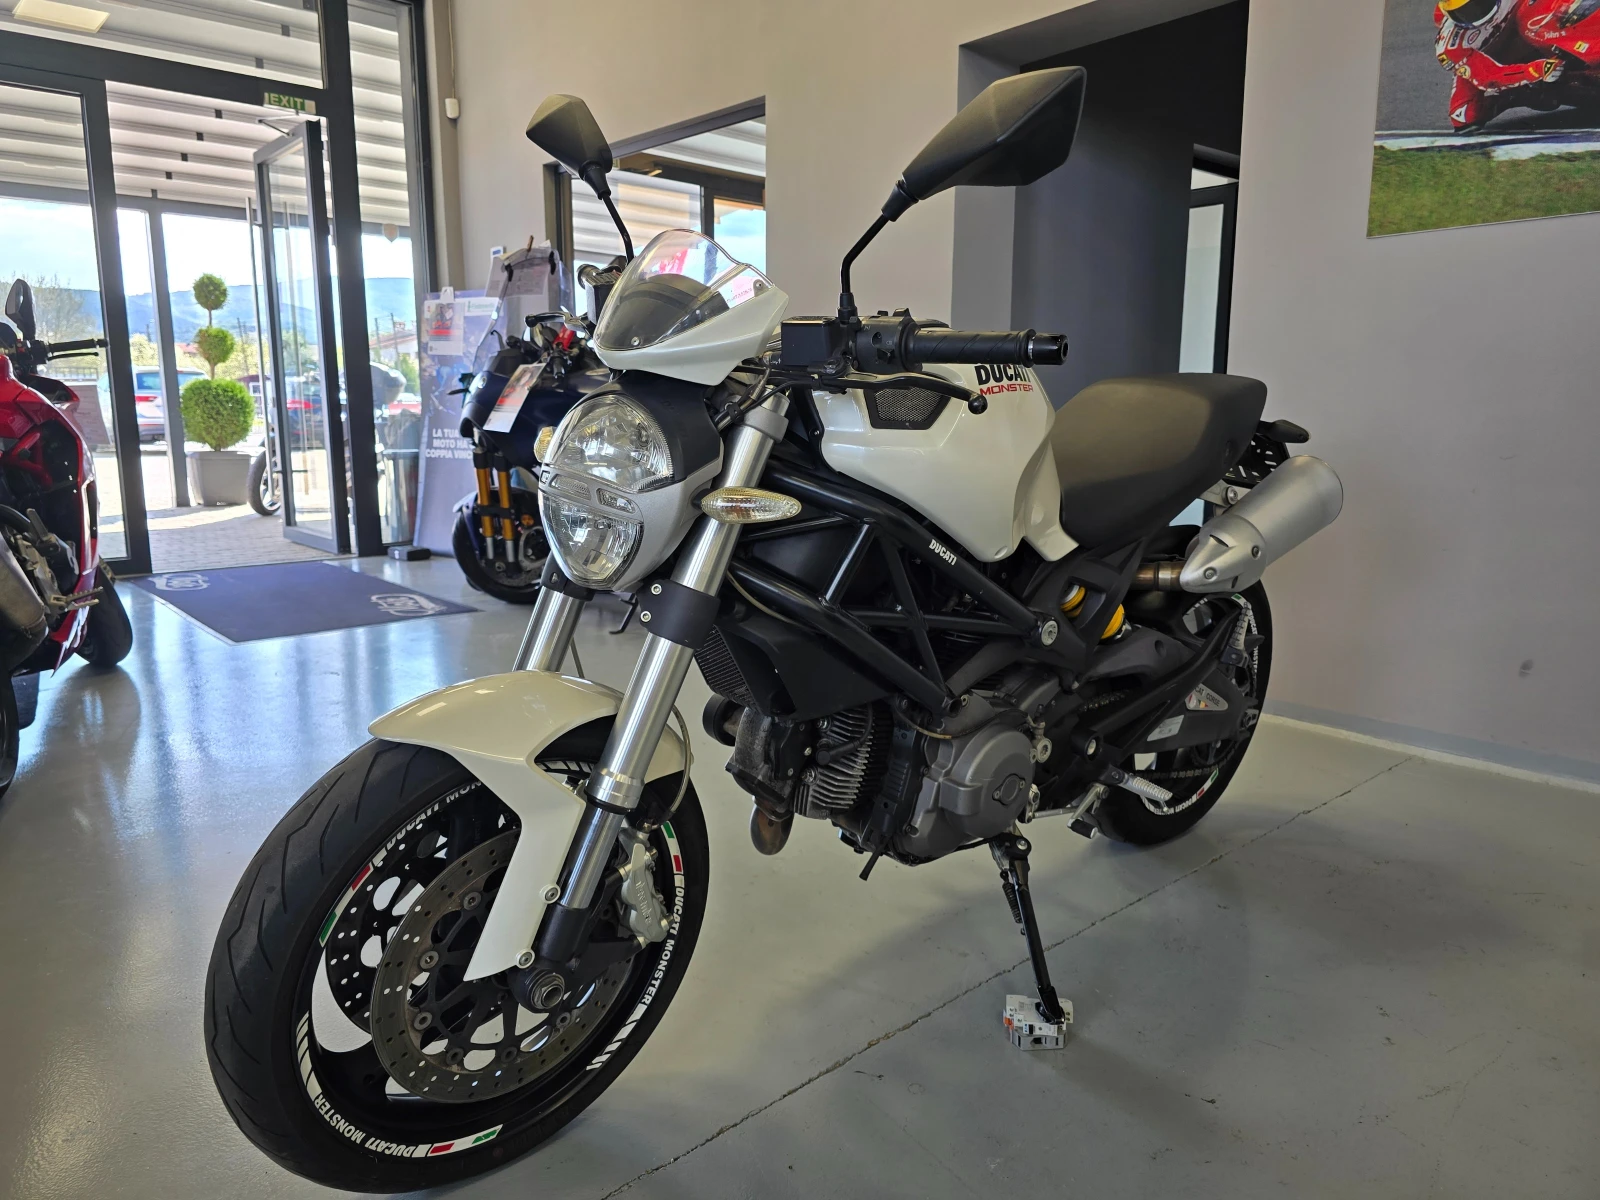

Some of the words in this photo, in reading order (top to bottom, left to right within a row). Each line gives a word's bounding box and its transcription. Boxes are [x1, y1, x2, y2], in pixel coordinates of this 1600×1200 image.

[270, 93, 303, 109] EXIT
[980, 383, 1034, 396] MONSTER
[433, 428, 442, 438] LA
[444, 429, 460, 438] TUA
[433, 438, 456, 448] MOTO
[456, 439, 468, 449] HA
[425, 448, 453, 459] COPPIA
[929, 539, 957, 566] DUCATI
[669, 887, 685, 936] DUCATI
[641, 939, 675, 1005] MONSTER
[314, 1094, 367, 1145] MONSTER
[364, 1137, 417, 1158] DUCATI
